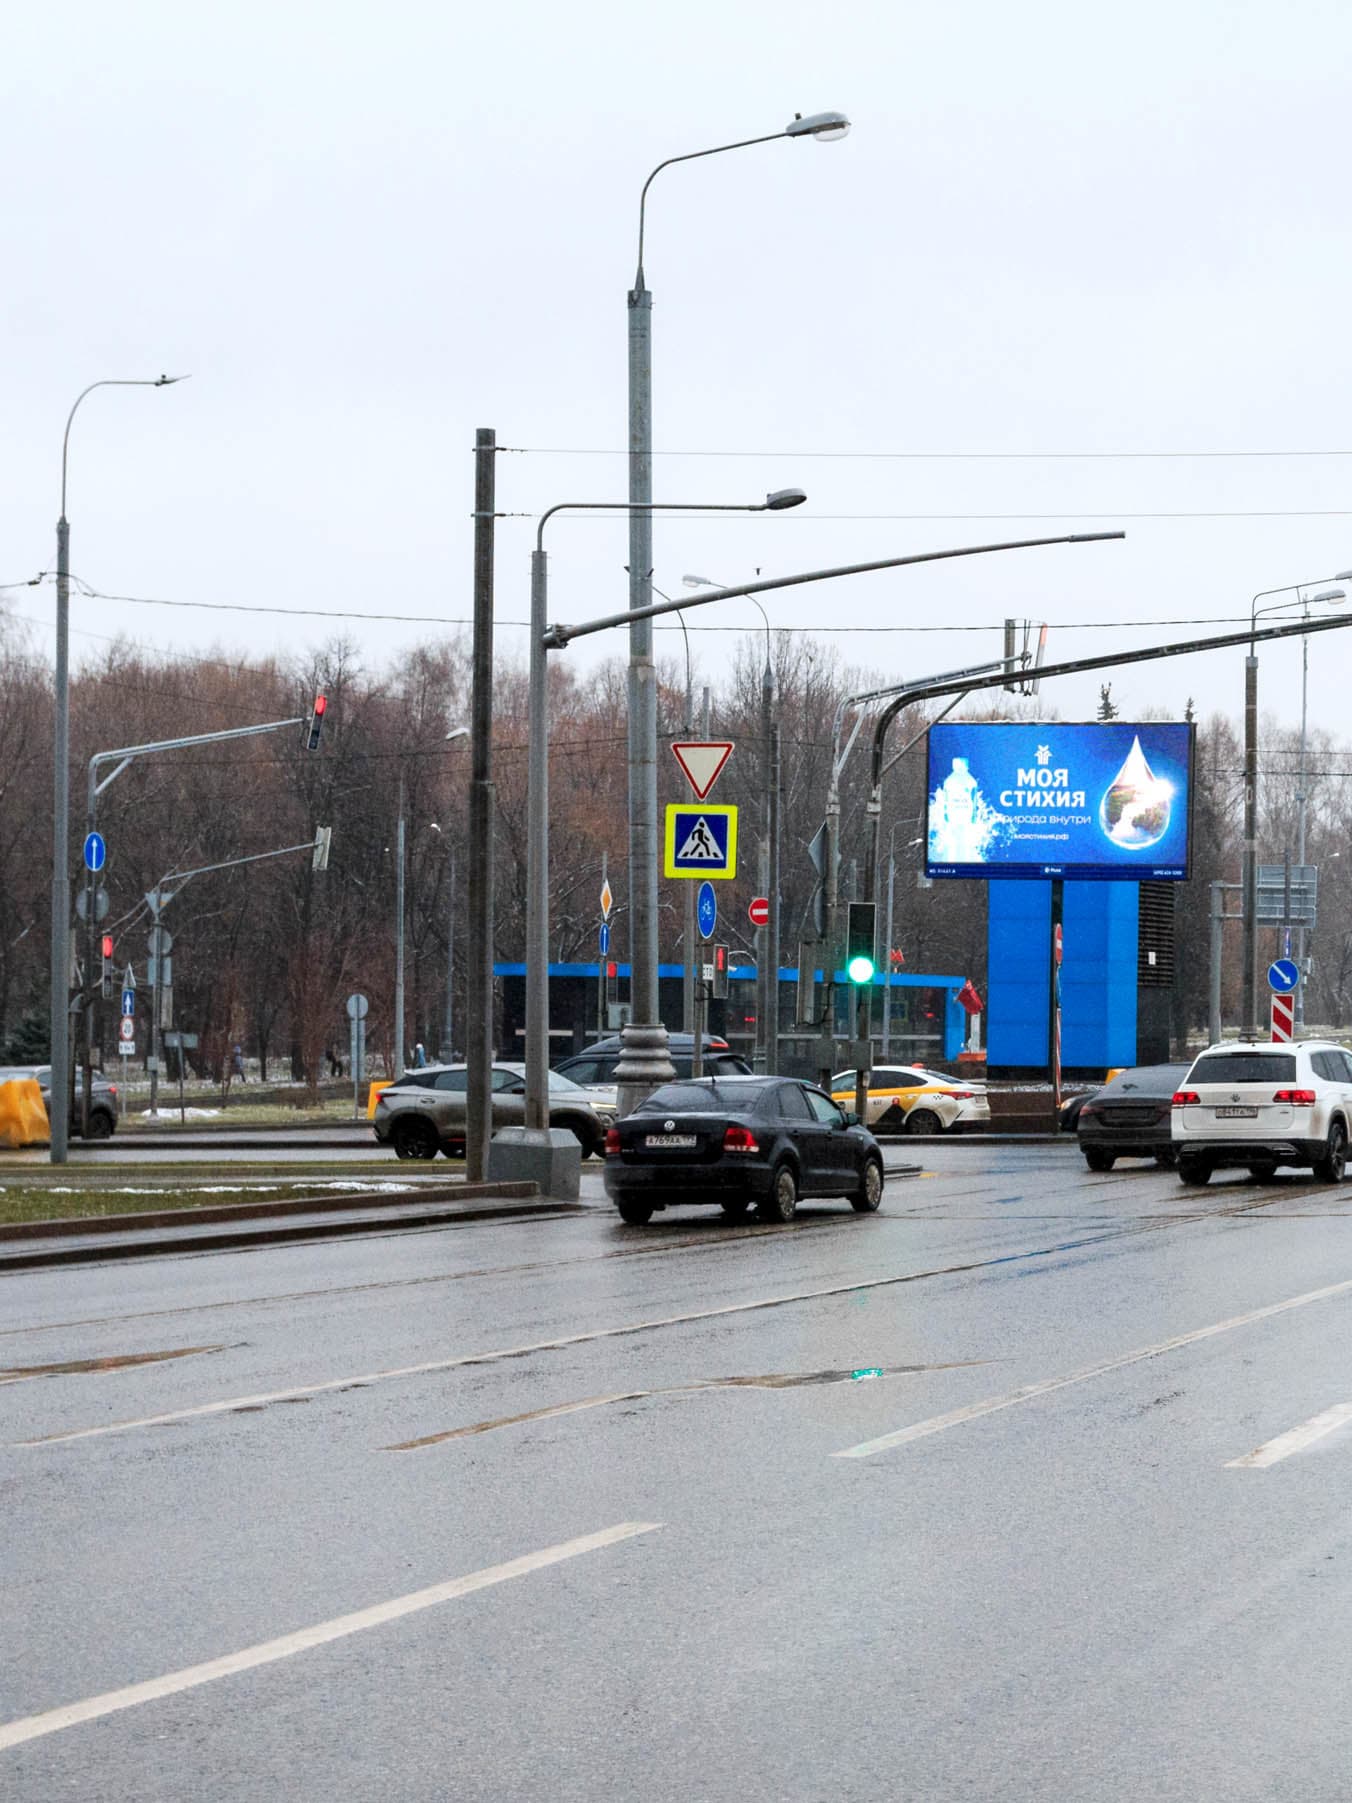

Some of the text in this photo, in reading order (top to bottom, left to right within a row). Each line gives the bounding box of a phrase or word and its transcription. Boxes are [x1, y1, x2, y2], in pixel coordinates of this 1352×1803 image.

[1017, 768, 1069, 787] МОЯ
[1000, 790, 1086, 808] СТИХИЯ
[995, 814, 1092, 825] рирода внутри
